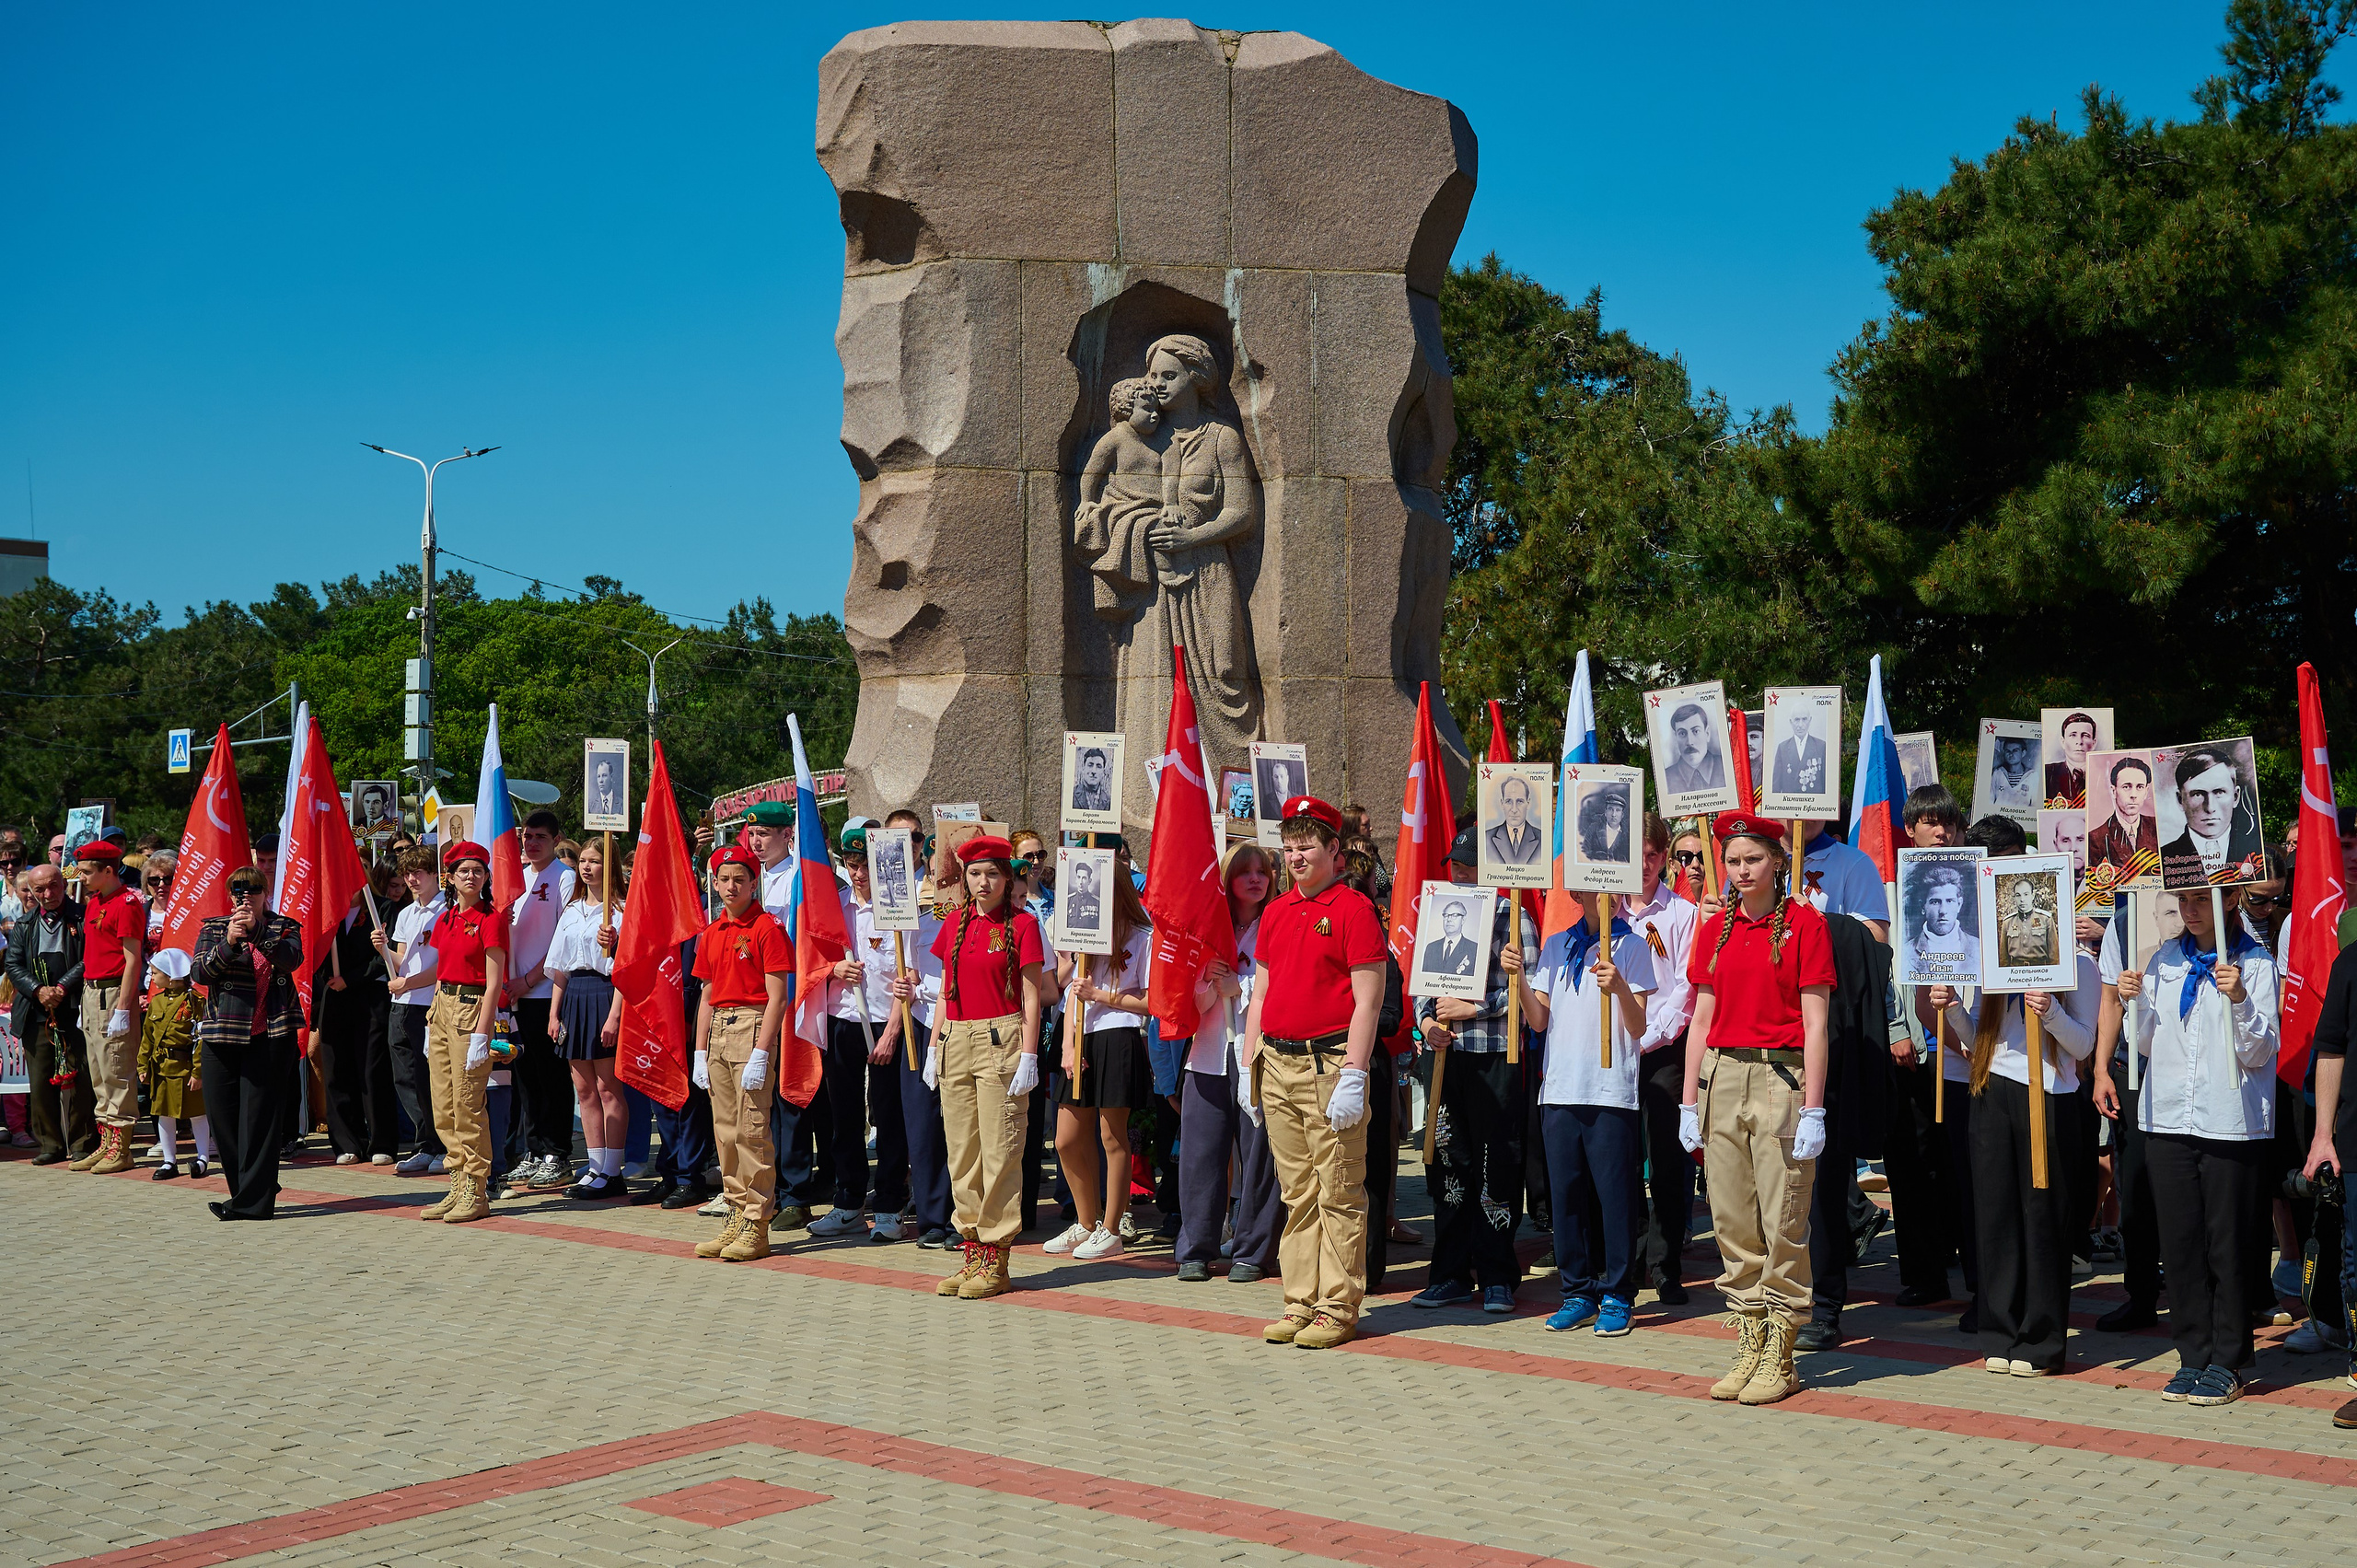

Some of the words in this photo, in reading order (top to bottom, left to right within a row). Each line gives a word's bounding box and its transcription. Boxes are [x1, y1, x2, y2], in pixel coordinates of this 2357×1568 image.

[1901, 853, 1938, 862] Спасибо
[1486, 873, 1514, 881] Григорий
[1514, 874, 1545, 882] Петрович
[1919, 952, 1966, 963] Андреев
[1929, 963, 1953, 972] Иван
[1908, 971, 1977, 982] Харлампиевич
[2304, 1260, 2314, 1284] Nikon
